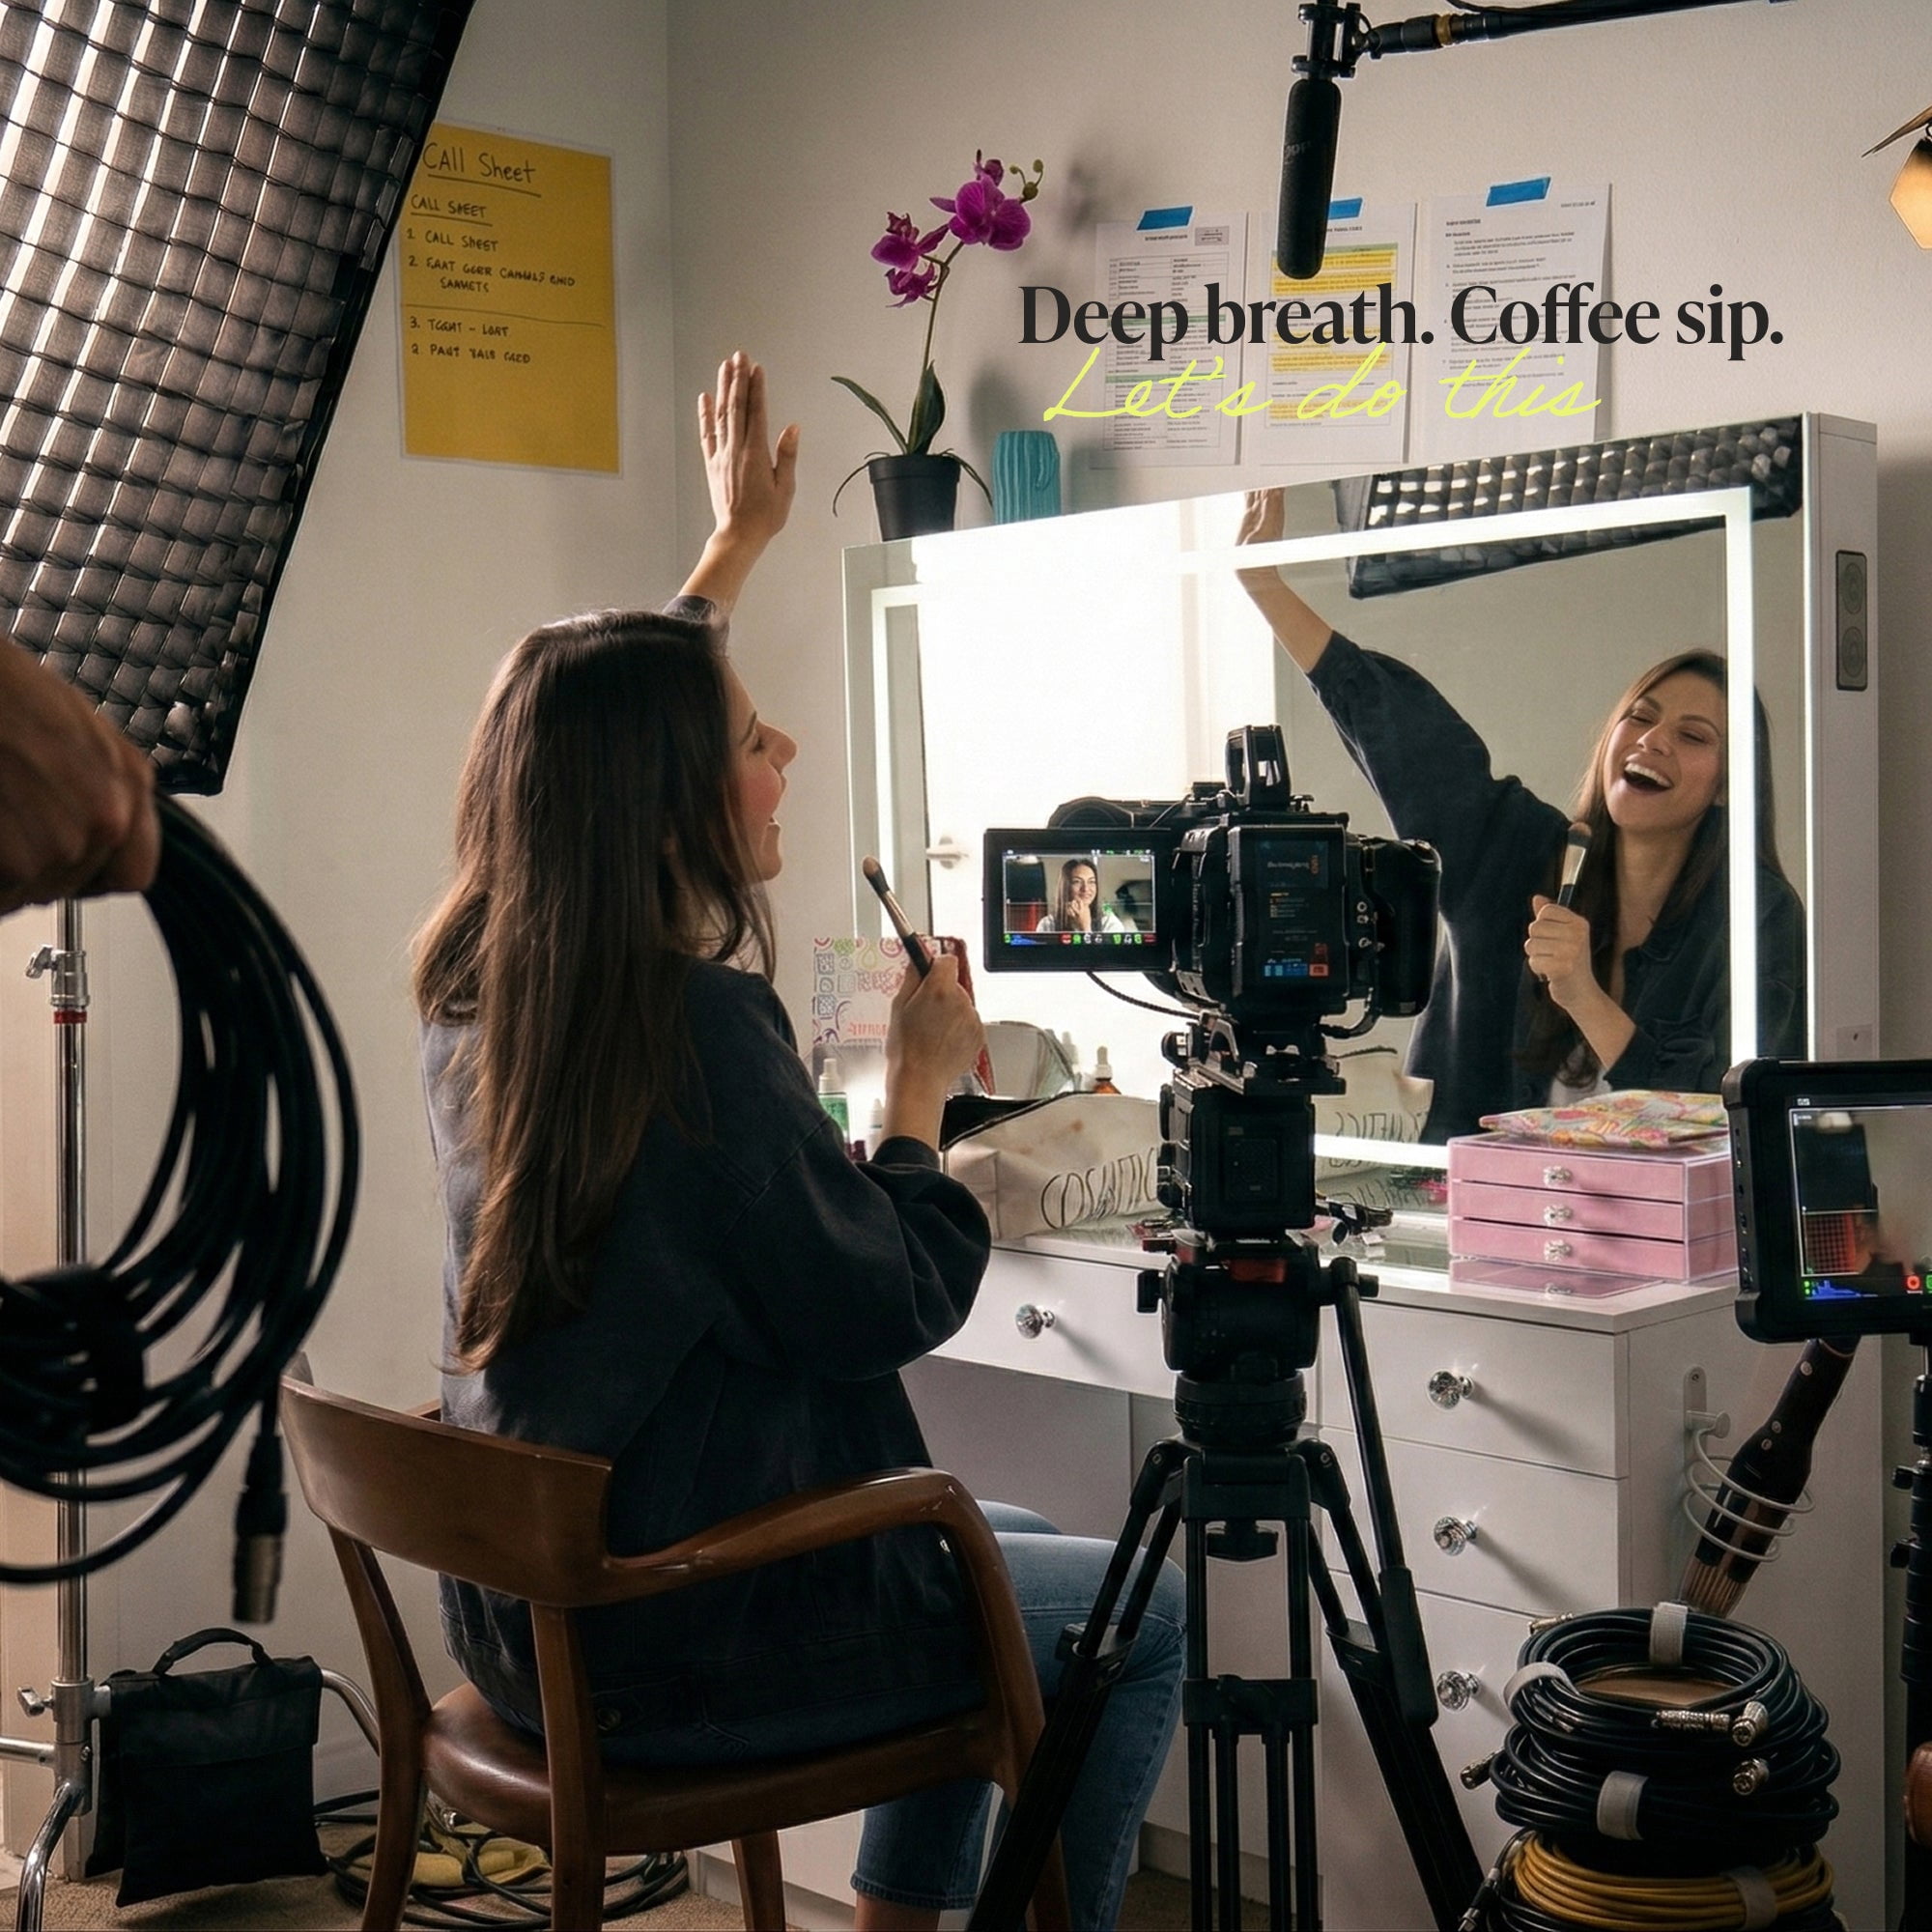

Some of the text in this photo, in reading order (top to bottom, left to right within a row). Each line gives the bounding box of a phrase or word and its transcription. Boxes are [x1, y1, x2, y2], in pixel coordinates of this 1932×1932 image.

[478, 152, 536, 184] Sheet
[411, 193, 440, 212] CALL
[425, 229, 454, 246] CALL
[410, 315, 421, 329] 3.
